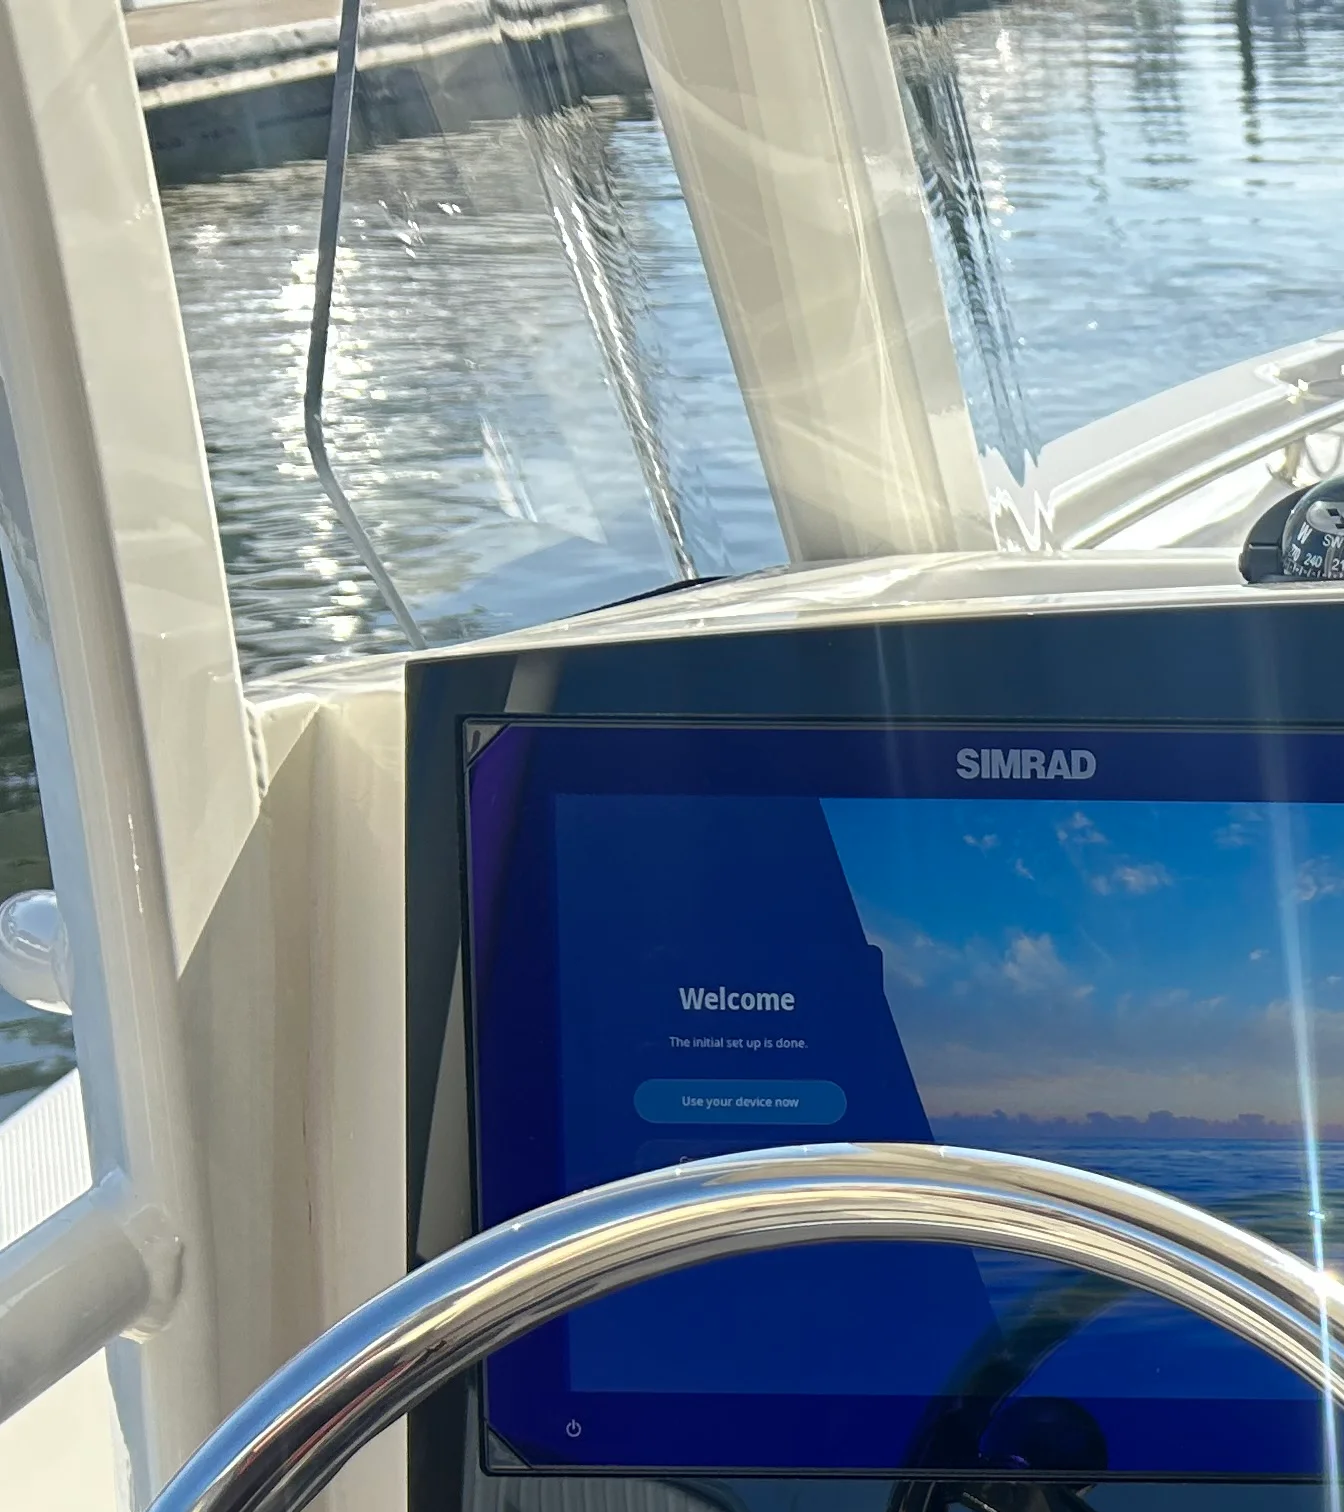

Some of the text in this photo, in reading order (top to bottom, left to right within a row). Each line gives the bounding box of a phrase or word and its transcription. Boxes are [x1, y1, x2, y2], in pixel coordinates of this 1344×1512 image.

[1296, 521, 1313, 546] W
[1322, 534, 1344, 549] SW
[1304, 552, 1324, 569] 240
[956, 747, 1097, 780] SIMRAD
[678, 986, 796, 1011] Welcome
[669, 1036, 809, 1051] The initial set up is done.
[681, 1095, 799, 1110] Use your device now
